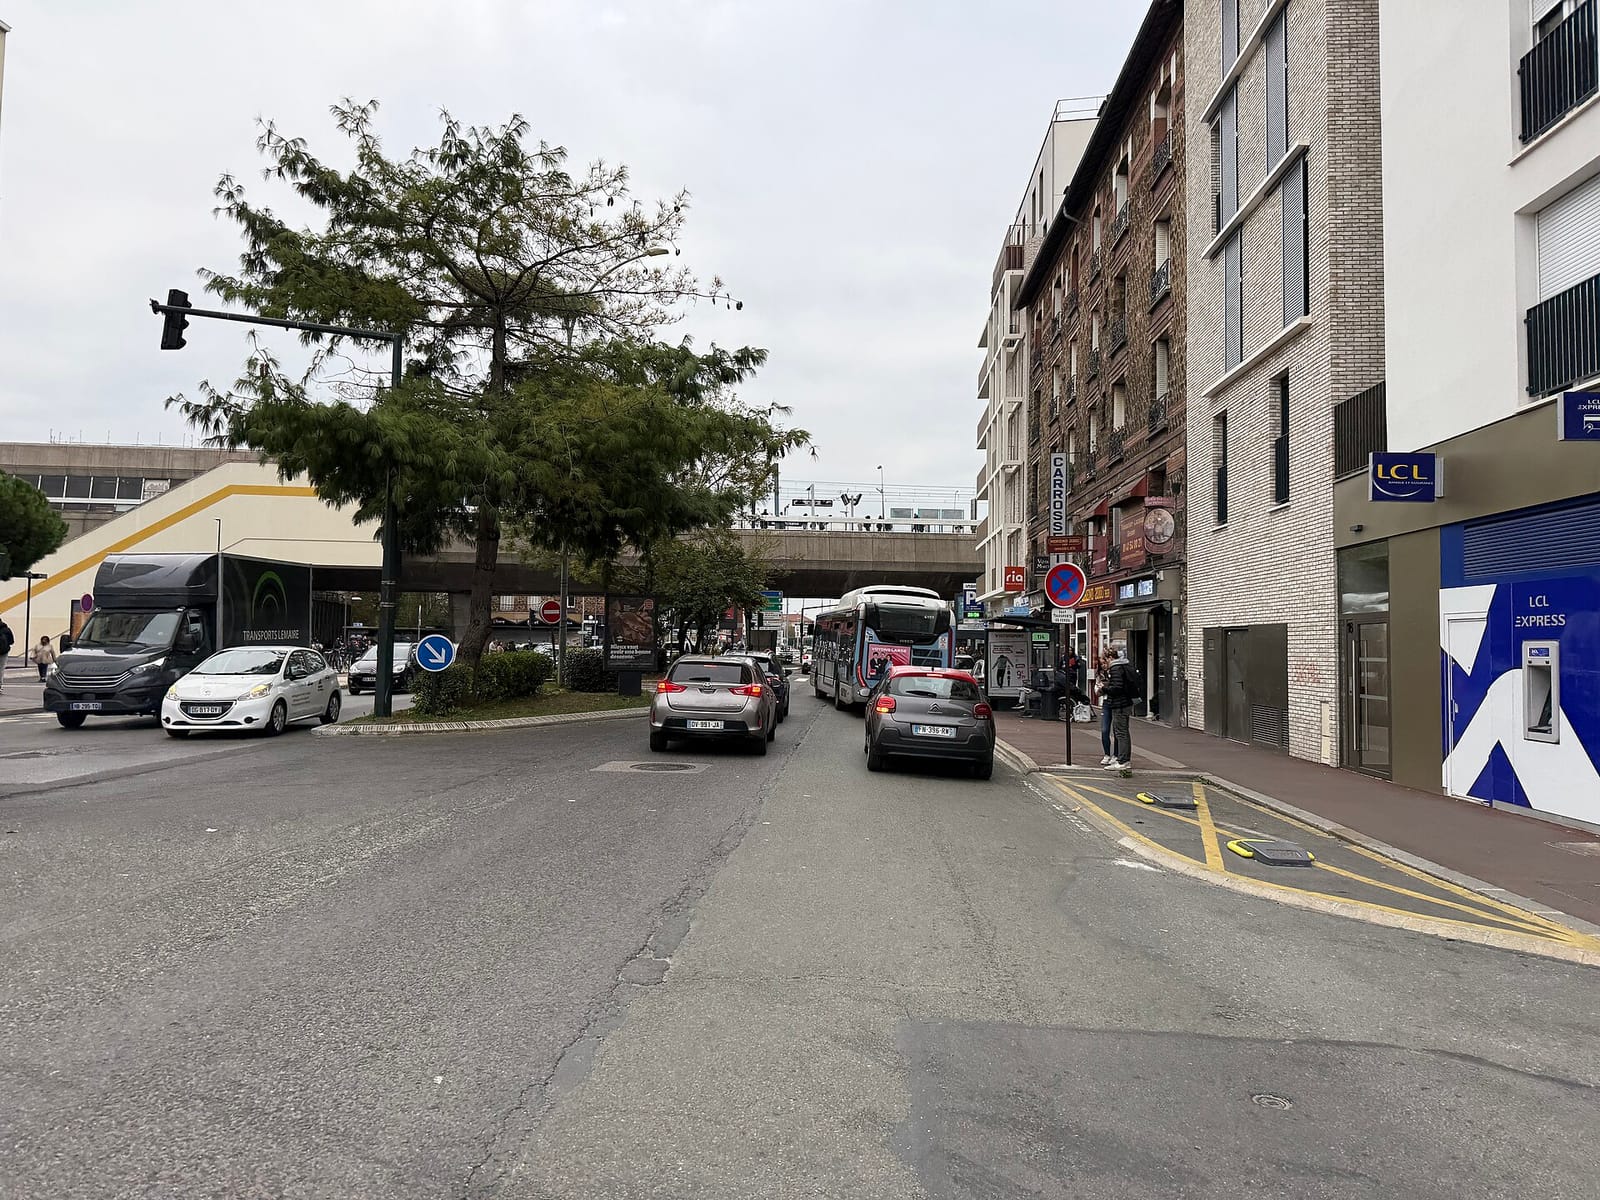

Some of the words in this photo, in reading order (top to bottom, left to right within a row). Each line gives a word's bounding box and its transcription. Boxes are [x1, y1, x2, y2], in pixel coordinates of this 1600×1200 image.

[1377, 464, 1428, 480] LCL
[1006, 570, 1024, 582] ria
[1529, 595, 1550, 608] LCL
[1515, 614, 1566, 628] EXPRESS
[243, 630, 277, 640] TRANSPORTS
[278, 630, 299, 640] LEMAIRE
